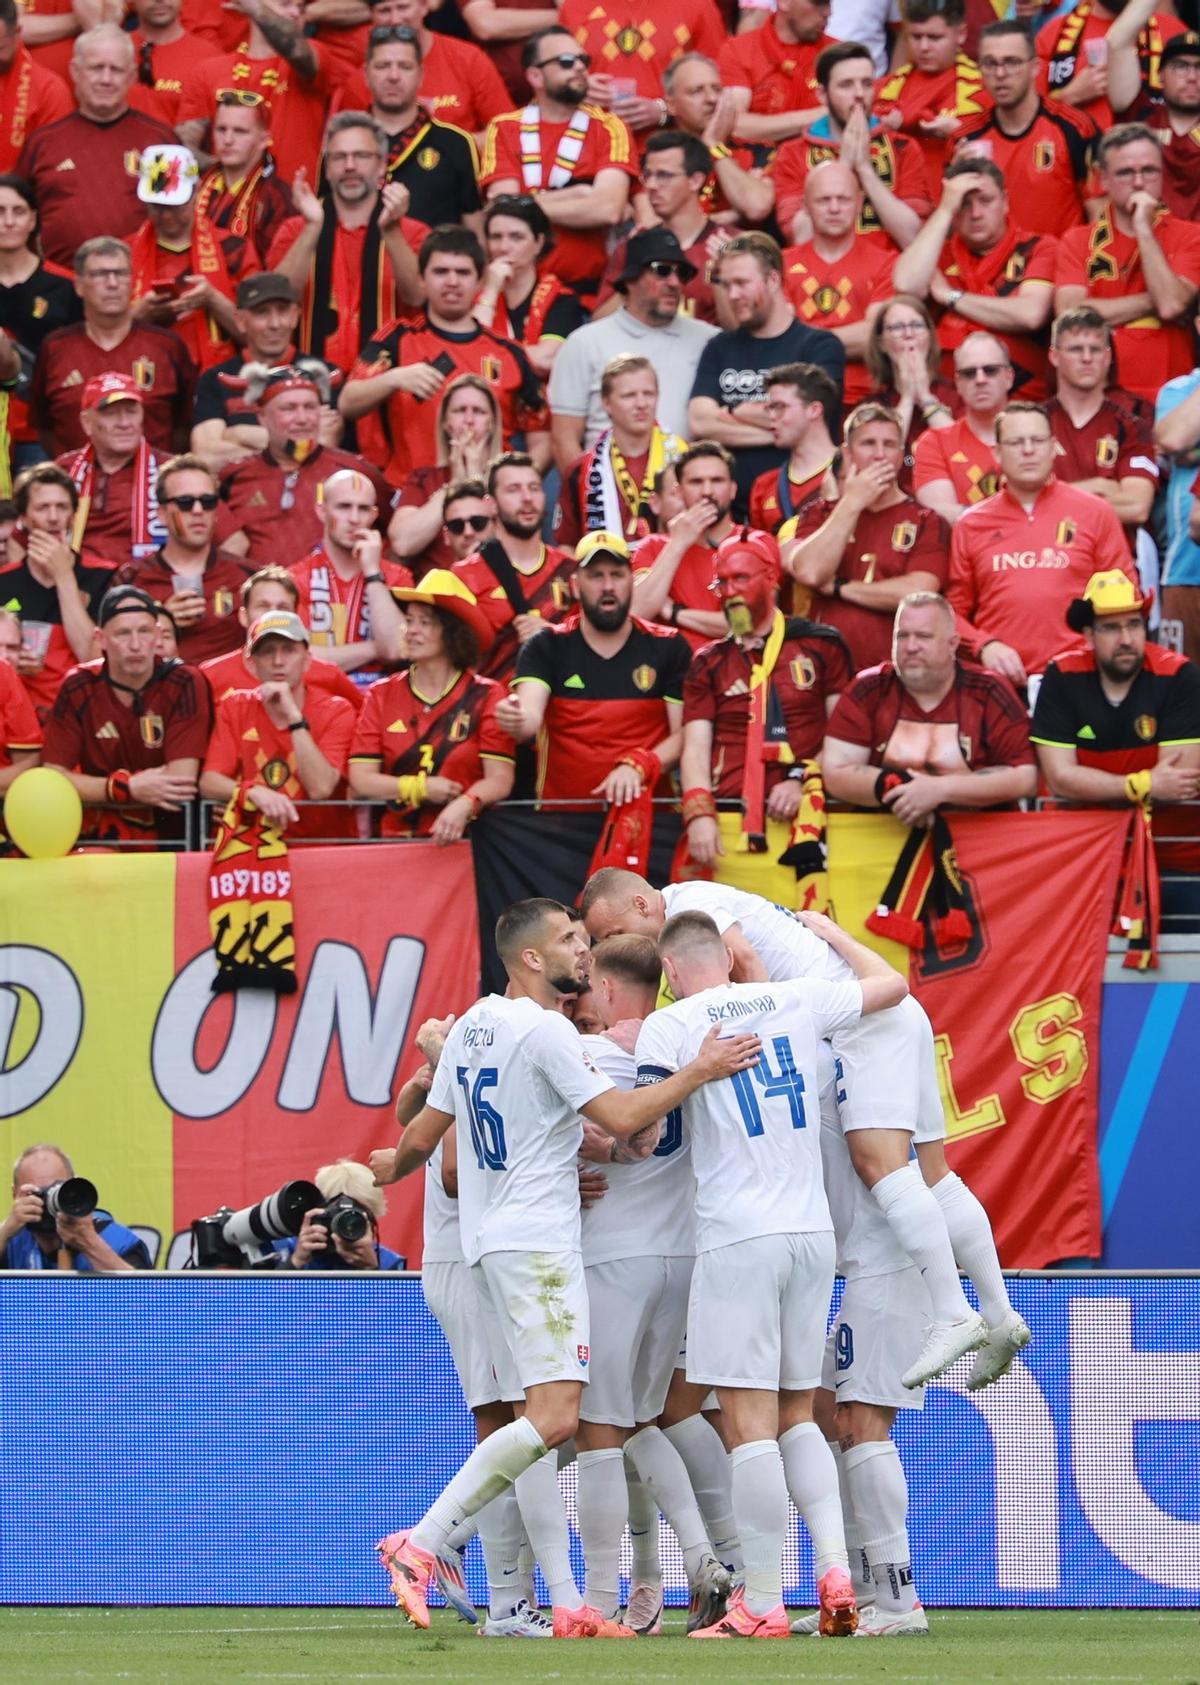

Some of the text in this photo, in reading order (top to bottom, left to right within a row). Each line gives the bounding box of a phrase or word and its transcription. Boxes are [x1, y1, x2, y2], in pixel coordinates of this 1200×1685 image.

[992, 551, 1037, 572] ING
[150, 936, 427, 1120] ON
[456, 1065, 508, 1171] 16
[715, 1033, 807, 1138] 14
